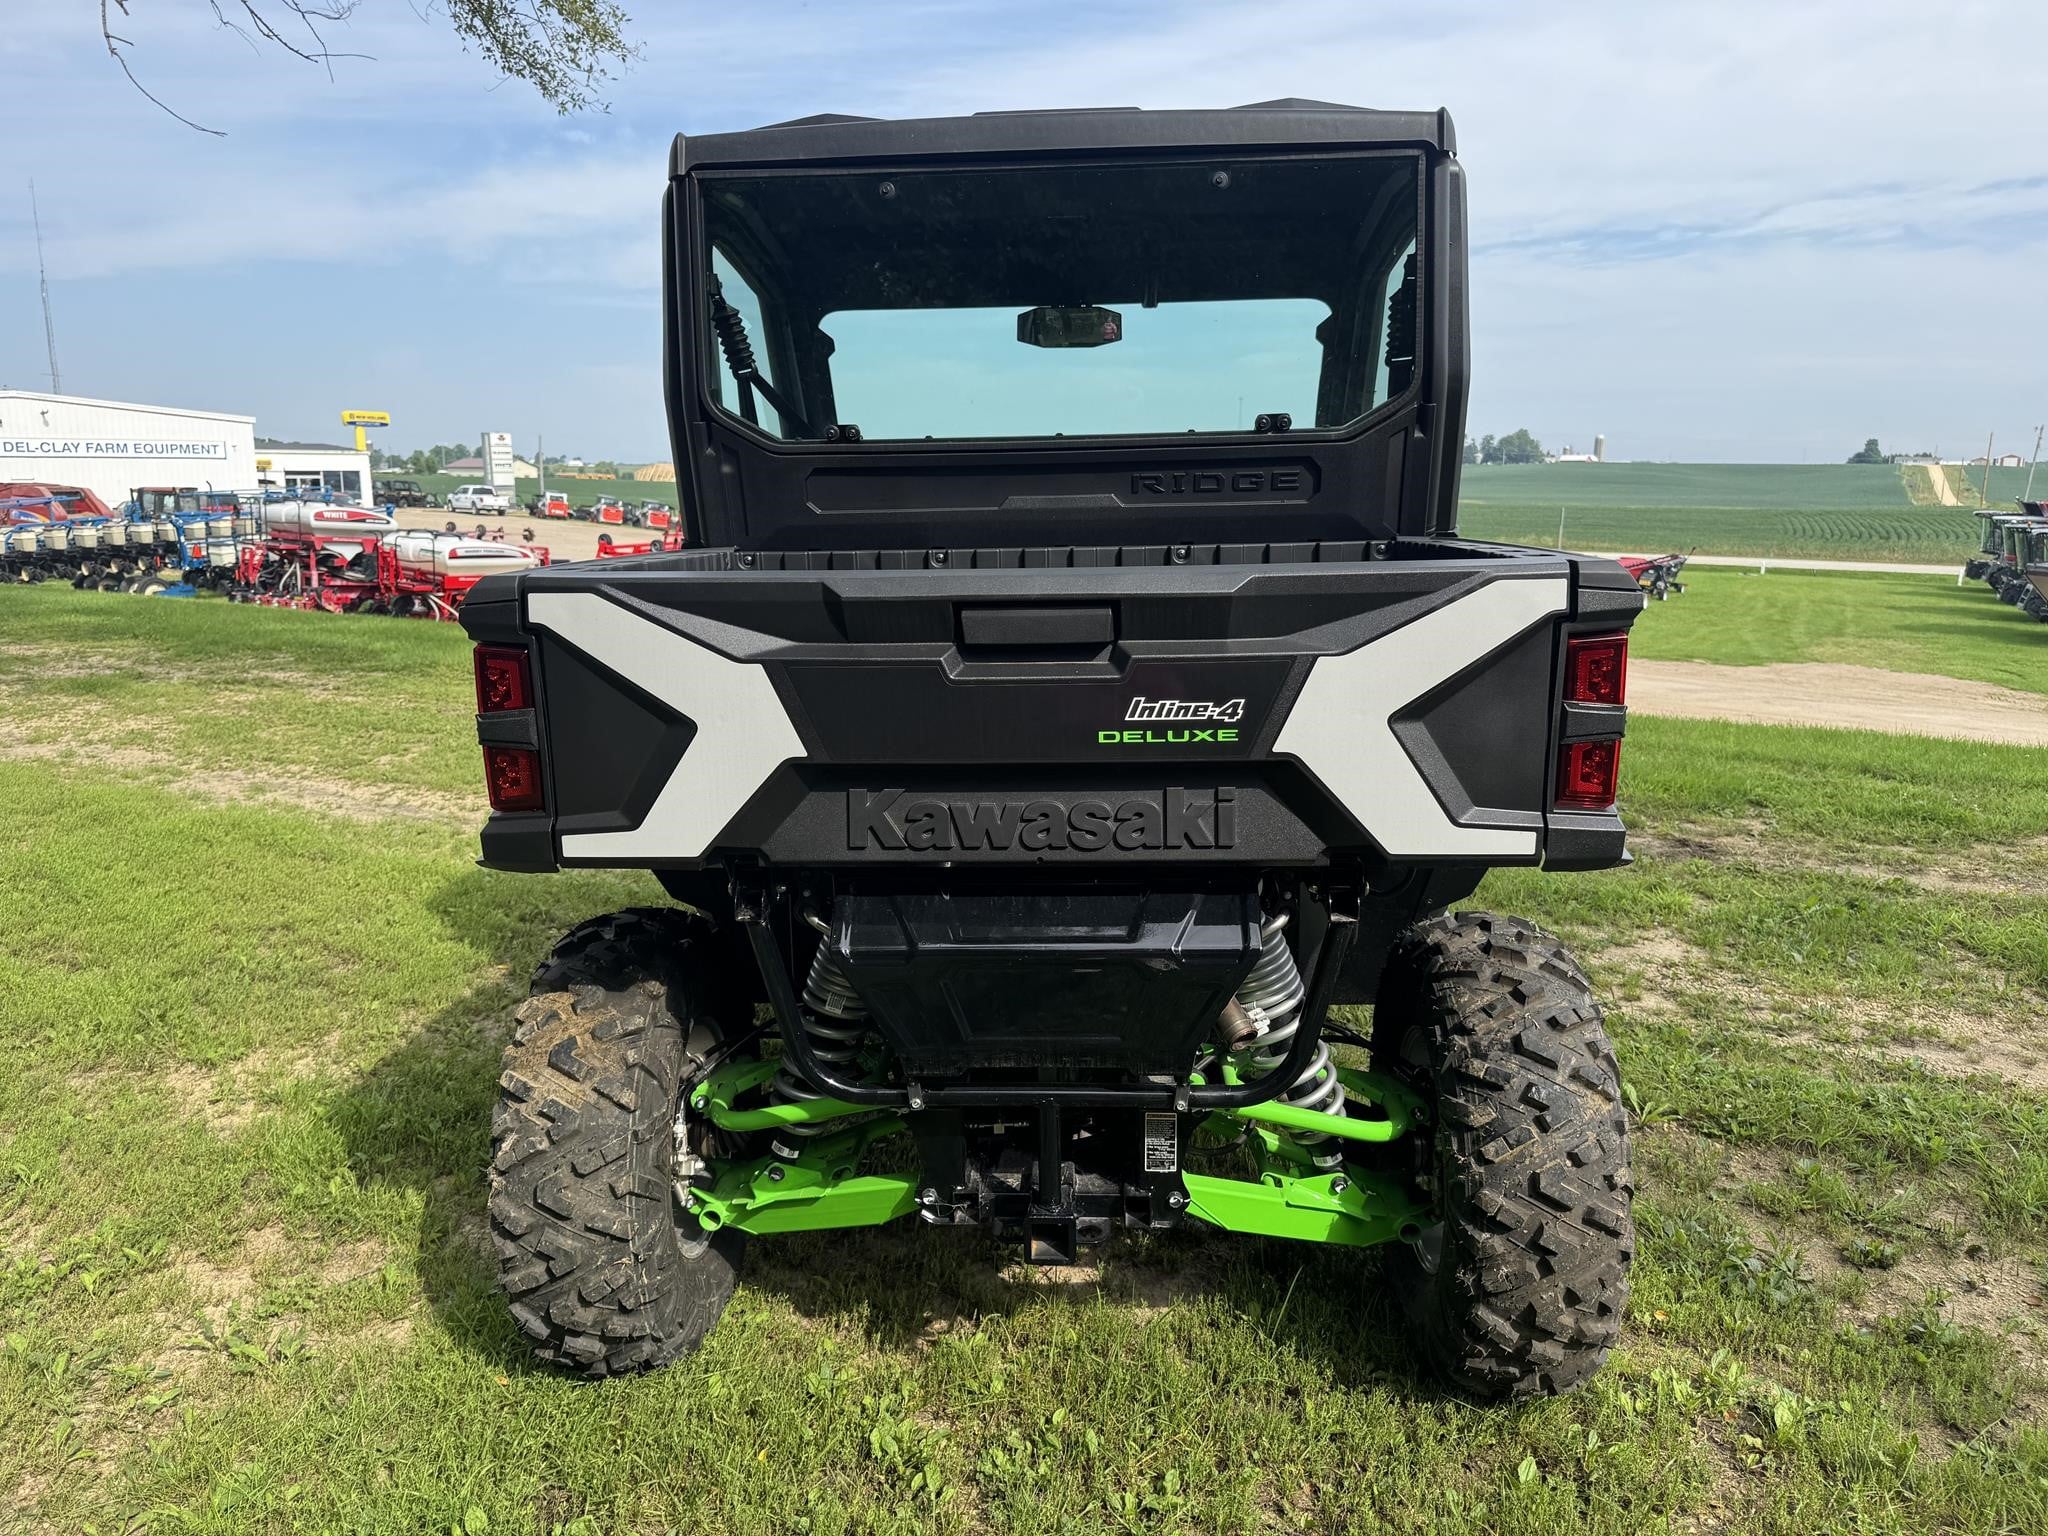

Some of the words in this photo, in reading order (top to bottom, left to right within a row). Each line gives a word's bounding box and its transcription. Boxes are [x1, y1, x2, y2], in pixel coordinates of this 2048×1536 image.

[3, 441, 81, 454] DEL-CLAY
[85, 442, 129, 455] FARM
[133, 442, 220, 455] EQUIPMENT
[1130, 470, 1301, 495] RIDGE
[1124, 696, 1246, 722] Inline-4
[1098, 729, 1240, 744] DELUXE
[847, 785, 1238, 851] Kawasaki
